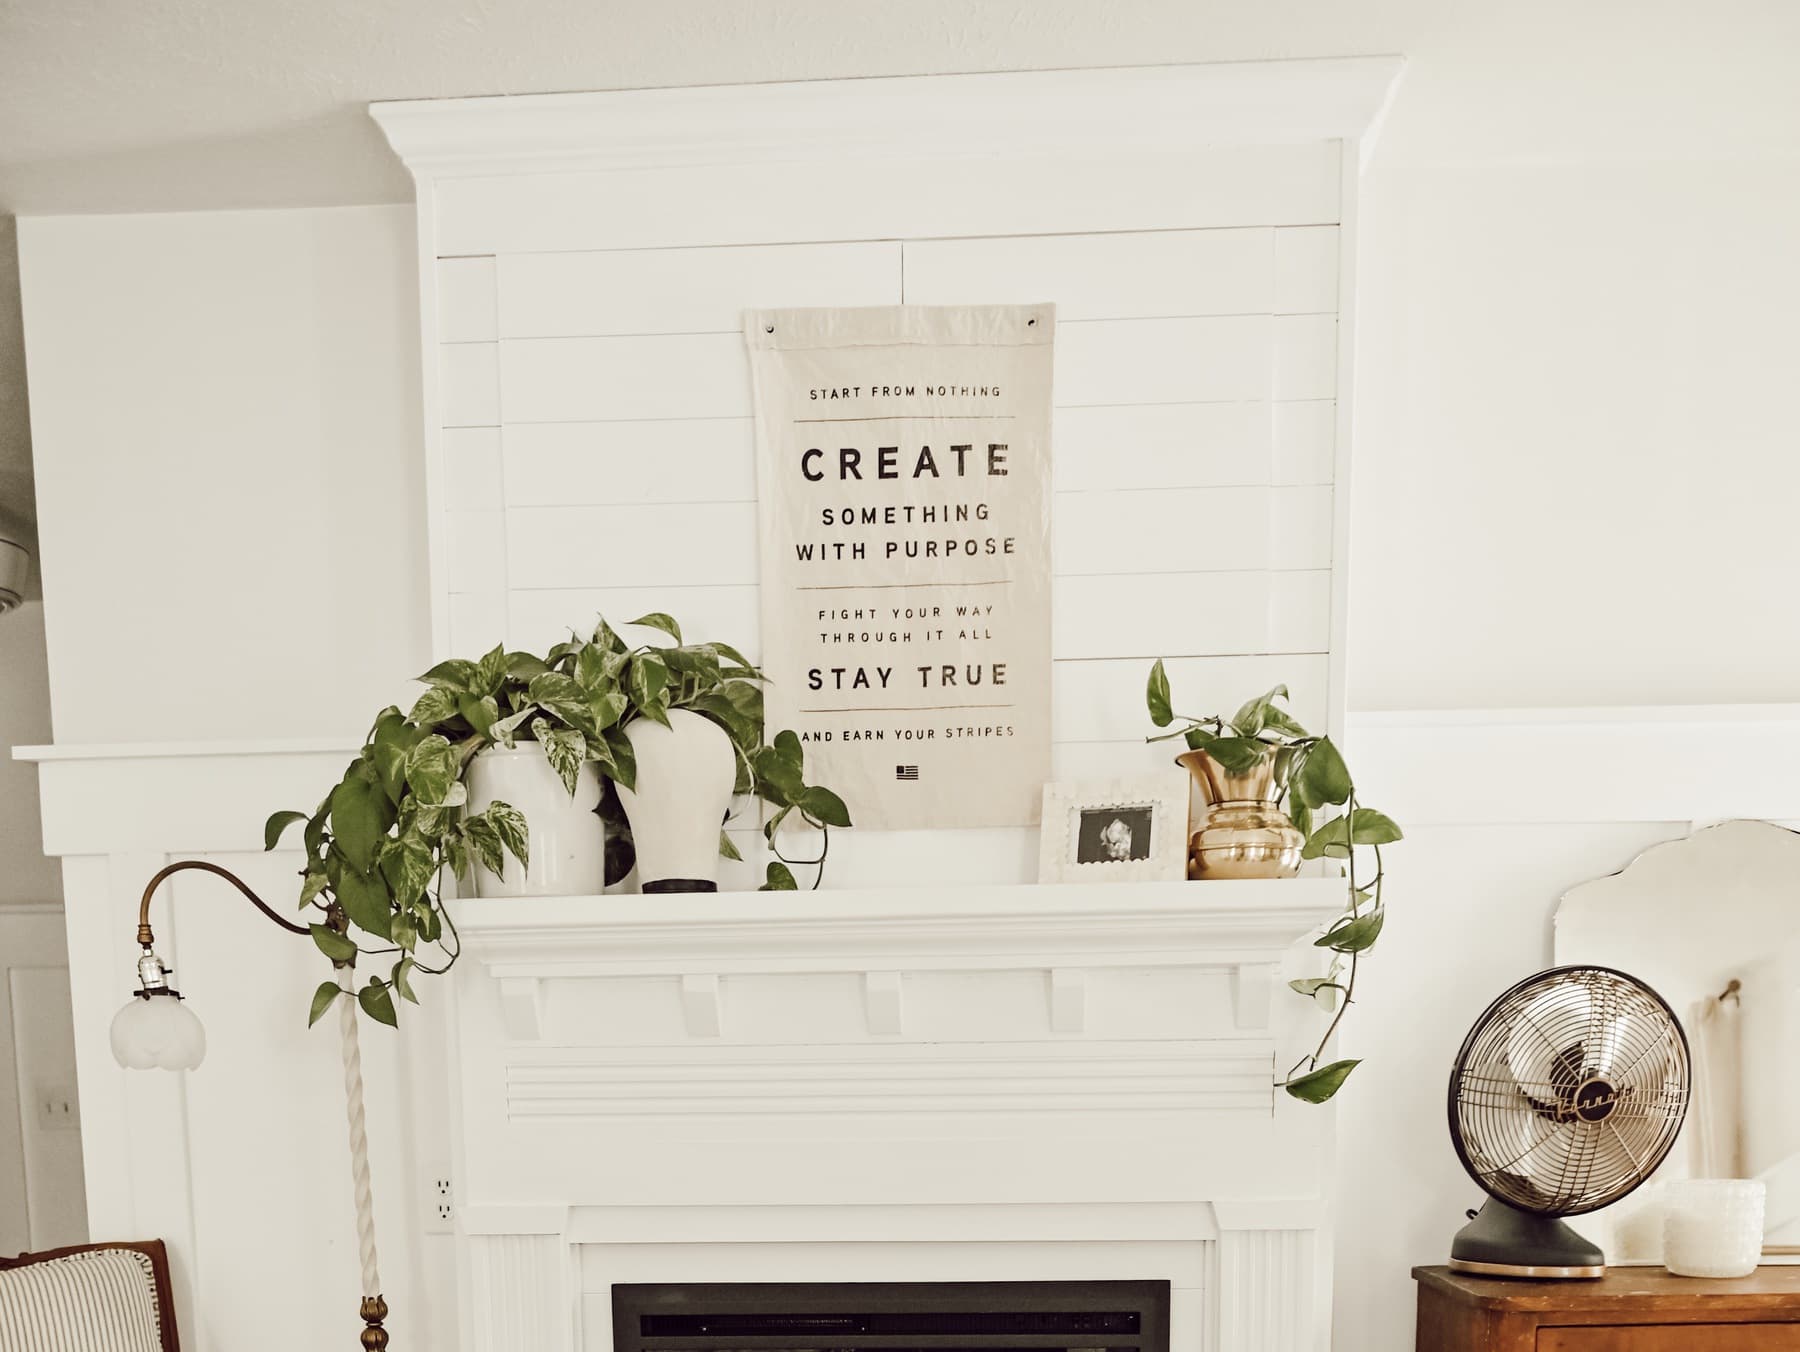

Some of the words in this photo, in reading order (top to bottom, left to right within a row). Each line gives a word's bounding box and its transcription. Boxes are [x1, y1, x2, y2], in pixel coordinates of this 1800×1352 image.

[810, 387, 860, 400] START
[872, 386, 914, 397] FROM
[927, 386, 999, 396] NOTHING
[801, 444, 1008, 482] CREATE
[822, 504, 988, 526] SOMETHING
[796, 542, 865, 561] WITH
[886, 538, 1015, 559] PURPOSE
[819, 609, 876, 621] FIGHT
[893, 607, 940, 619] YOUR
[957, 606, 992, 616] WAY
[820, 632, 911, 643] THROUGH
[927, 630, 943, 640] IT
[959, 629, 991, 639] ALL
[808, 667, 892, 690] STAY
[917, 664, 1006, 688] TRUE
[801, 731, 832, 743] AND
[843, 730, 883, 741] EARN
[895, 729, 934, 740] YOUR
[946, 726, 1013, 738] STRIPES
